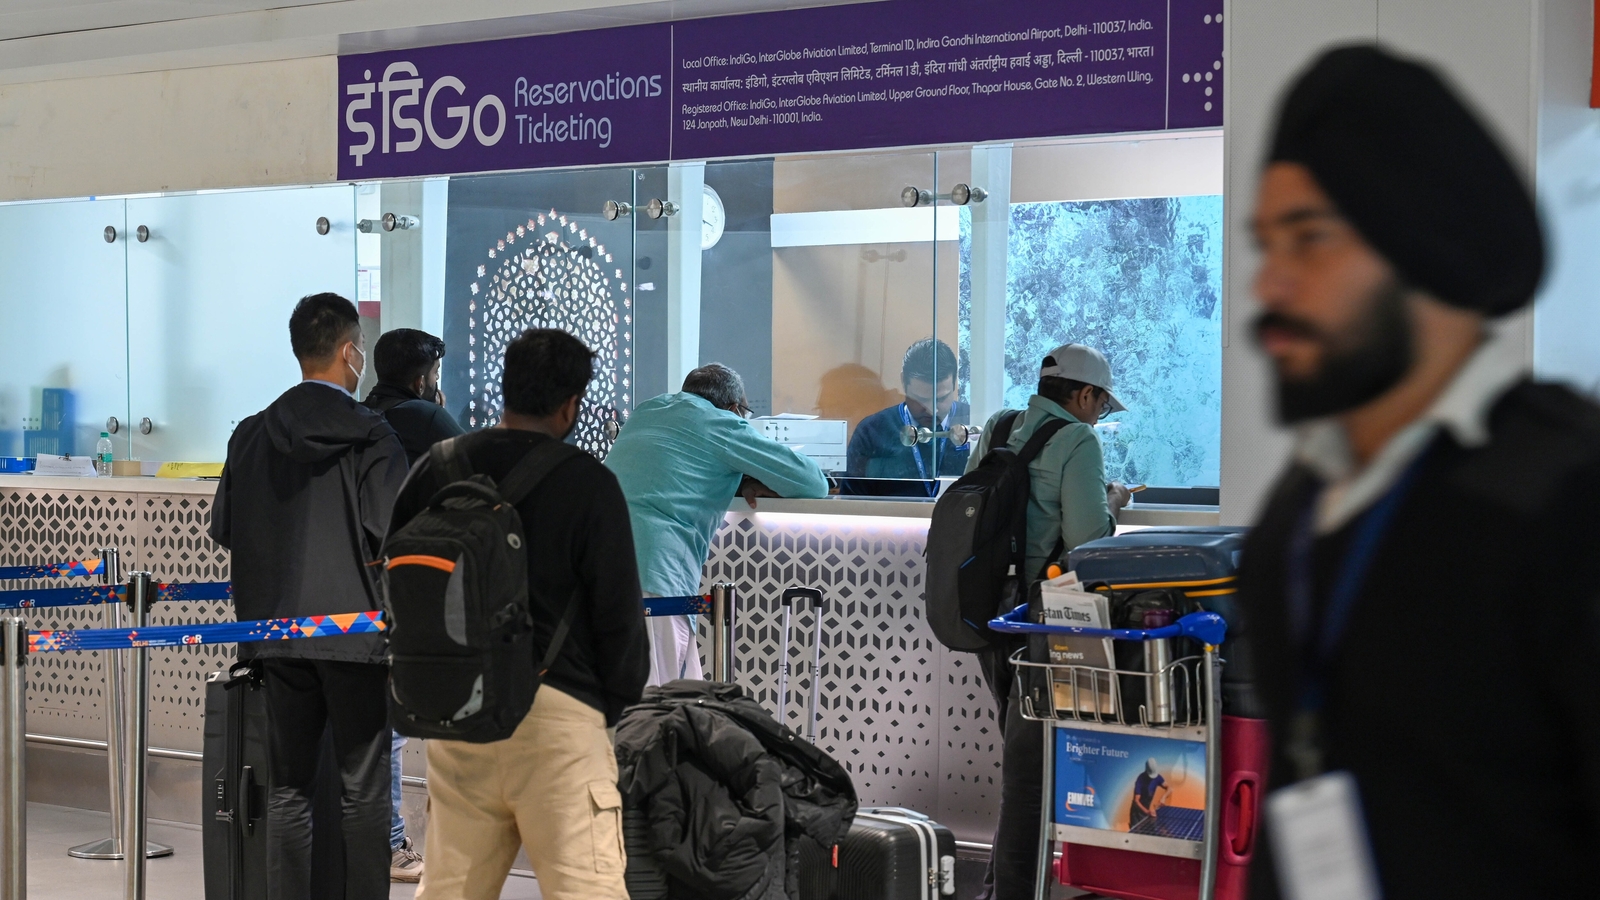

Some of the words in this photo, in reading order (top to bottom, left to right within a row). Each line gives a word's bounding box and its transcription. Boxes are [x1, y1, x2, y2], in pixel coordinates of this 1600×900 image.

[683, 58, 701, 68] Local
[703, 56, 728, 67] Office:
[730, 53, 757, 64] IndiGo,
[759, 50, 801, 62] InterGlobe
[803, 48, 836, 58] Aviation
[838, 43, 868, 55] Limited,
[870, 40, 903, 53] Terminal
[905, 39, 914, 50] 1D,
[917, 38, 939, 49] Indira
[942, 34, 973, 47] Gandhi
[975, 29, 1029, 44] International
[1031, 28, 1062, 41] Airport,
[1065, 25, 1087, 36] Delhi
[1093, 20, 1126, 34] 110037,
[1129, 19, 1153, 31] India.
[683, 79, 708, 92] स्थानीय
[710, 77, 743, 90] कार्यालय:
[746, 74, 769, 89] इंडिगो,
[772, 71, 804, 87] इंटरग्लोब
[807, 70, 839, 85] एविएशन
[841, 66, 873, 80] लिमिटेड,
[876, 64, 903, 78] टर्मिनल
[924, 60, 946, 75] इंदिरा
[948, 58, 967, 72] गांधी
[970, 55, 1007, 72] अंतर्राष्ट्रीय
[1010, 53, 1031, 69] हवाई
[1033, 54, 1054, 68] अड्डा,
[1057, 49, 1082, 63] दिल्ली
[1091, 48, 1124, 61] 110037,
[1127, 46, 1153, 57] भारत।
[514, 72, 662, 107] Reservations
[682, 102, 722, 116] Registered
[724, 101, 748, 111] Office:
[750, 98, 777, 109] IndiGo,
[779, 95, 821, 107] InterGlobe
[823, 94, 855, 104] Aviation
[858, 90, 887, 101] Limited,
[889, 89, 914, 102] Upper
[915, 85, 947, 97] Ground
[949, 85, 970, 95] Floor,
[972, 83, 1002, 95] Thapar
[1004, 81, 1033, 91] House,
[1035, 78, 1058, 89] Gate
[1060, 76, 1074, 87] No.
[1077, 75, 1085, 86] 2,
[1087, 74, 1125, 85] Western
[1127, 71, 1153, 84] Wing,
[515, 113, 612, 148] Ticketing
[683, 119, 696, 130] 124
[697, 118, 728, 130] Janpath,
[731, 117, 748, 126] New
[750, 115, 768, 125] Delhi
[773, 112, 799, 123] 110001,
[802, 112, 822, 122] India.
[1063, 606, 1091, 622] Times
[1061, 652, 1084, 660] news
[1066, 741, 1101, 757] Brighter
[1101, 746, 1129, 758] Future
